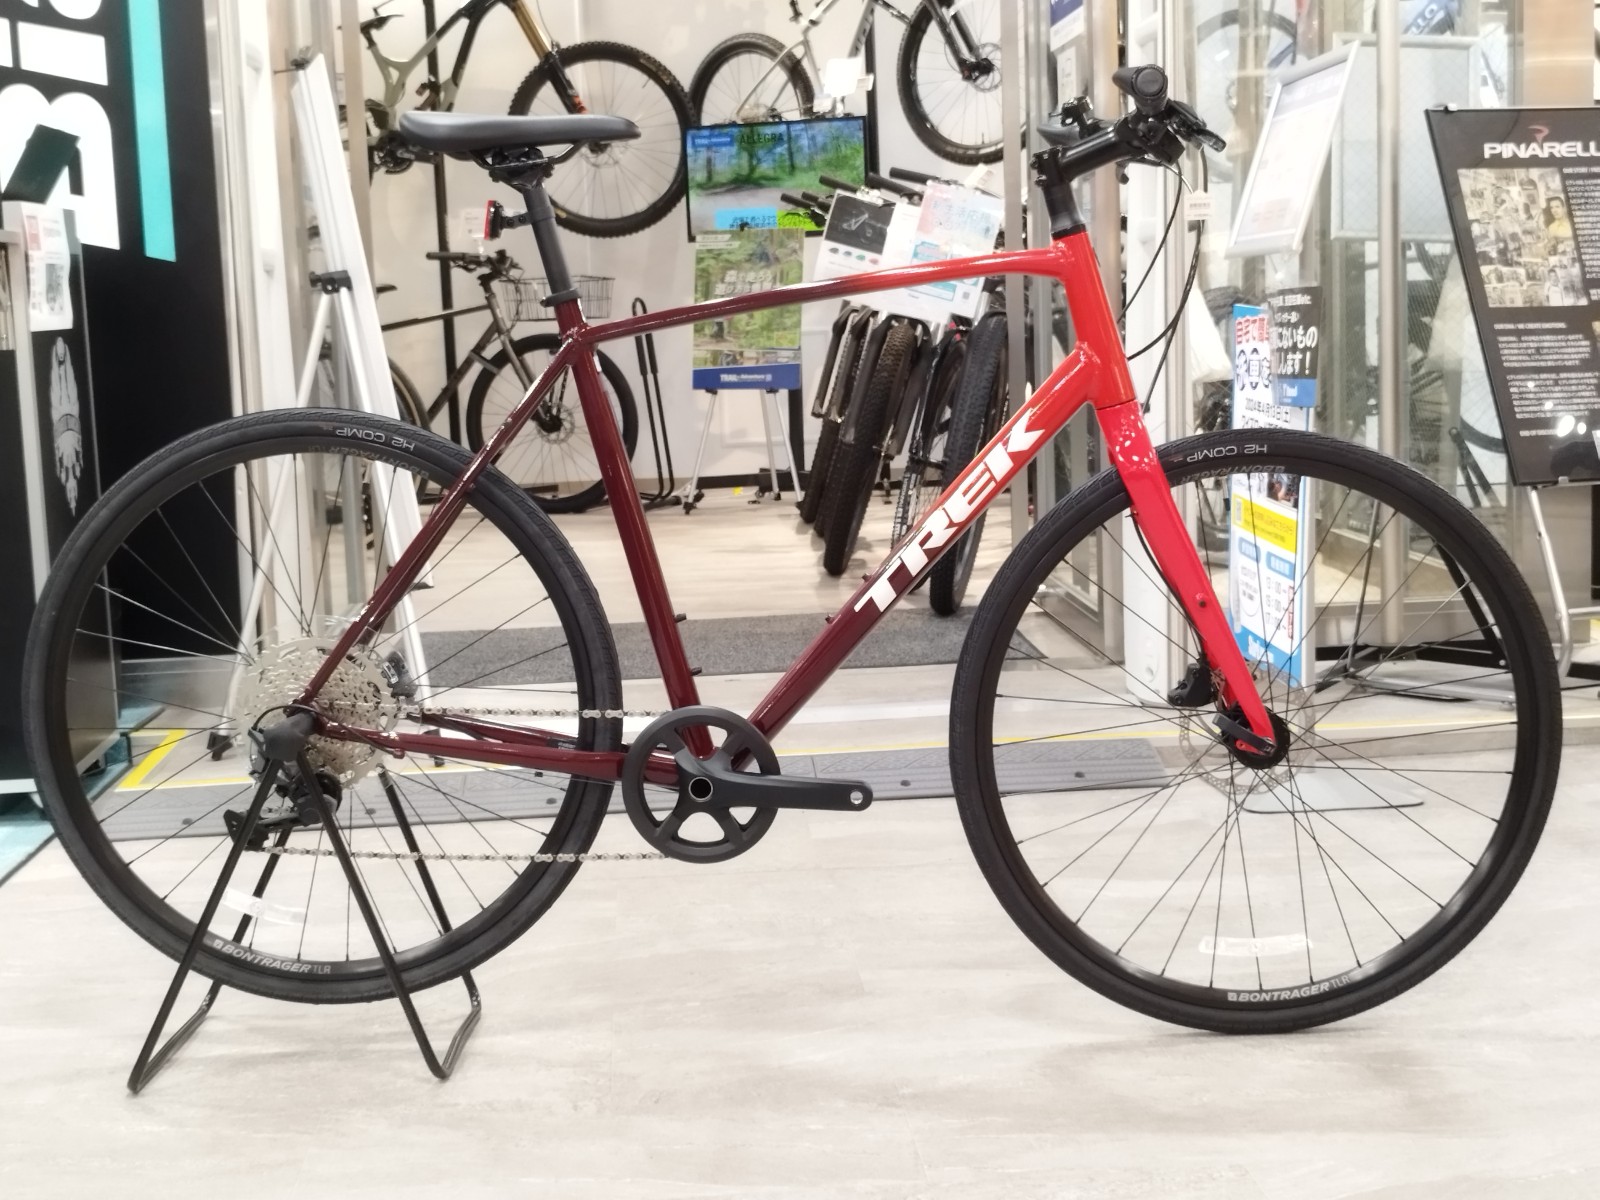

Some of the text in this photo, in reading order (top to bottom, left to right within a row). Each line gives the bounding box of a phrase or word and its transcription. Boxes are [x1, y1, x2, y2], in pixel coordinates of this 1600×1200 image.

[335, 427, 415, 452] H2 COMP
[1186, 444, 1268, 463] H2 COMP
[853, 407, 1046, 613] TREK
[221, 944, 331, 974] BONTRAGER TLR
[1237, 974, 1350, 1002] BONTRAGER TLR
